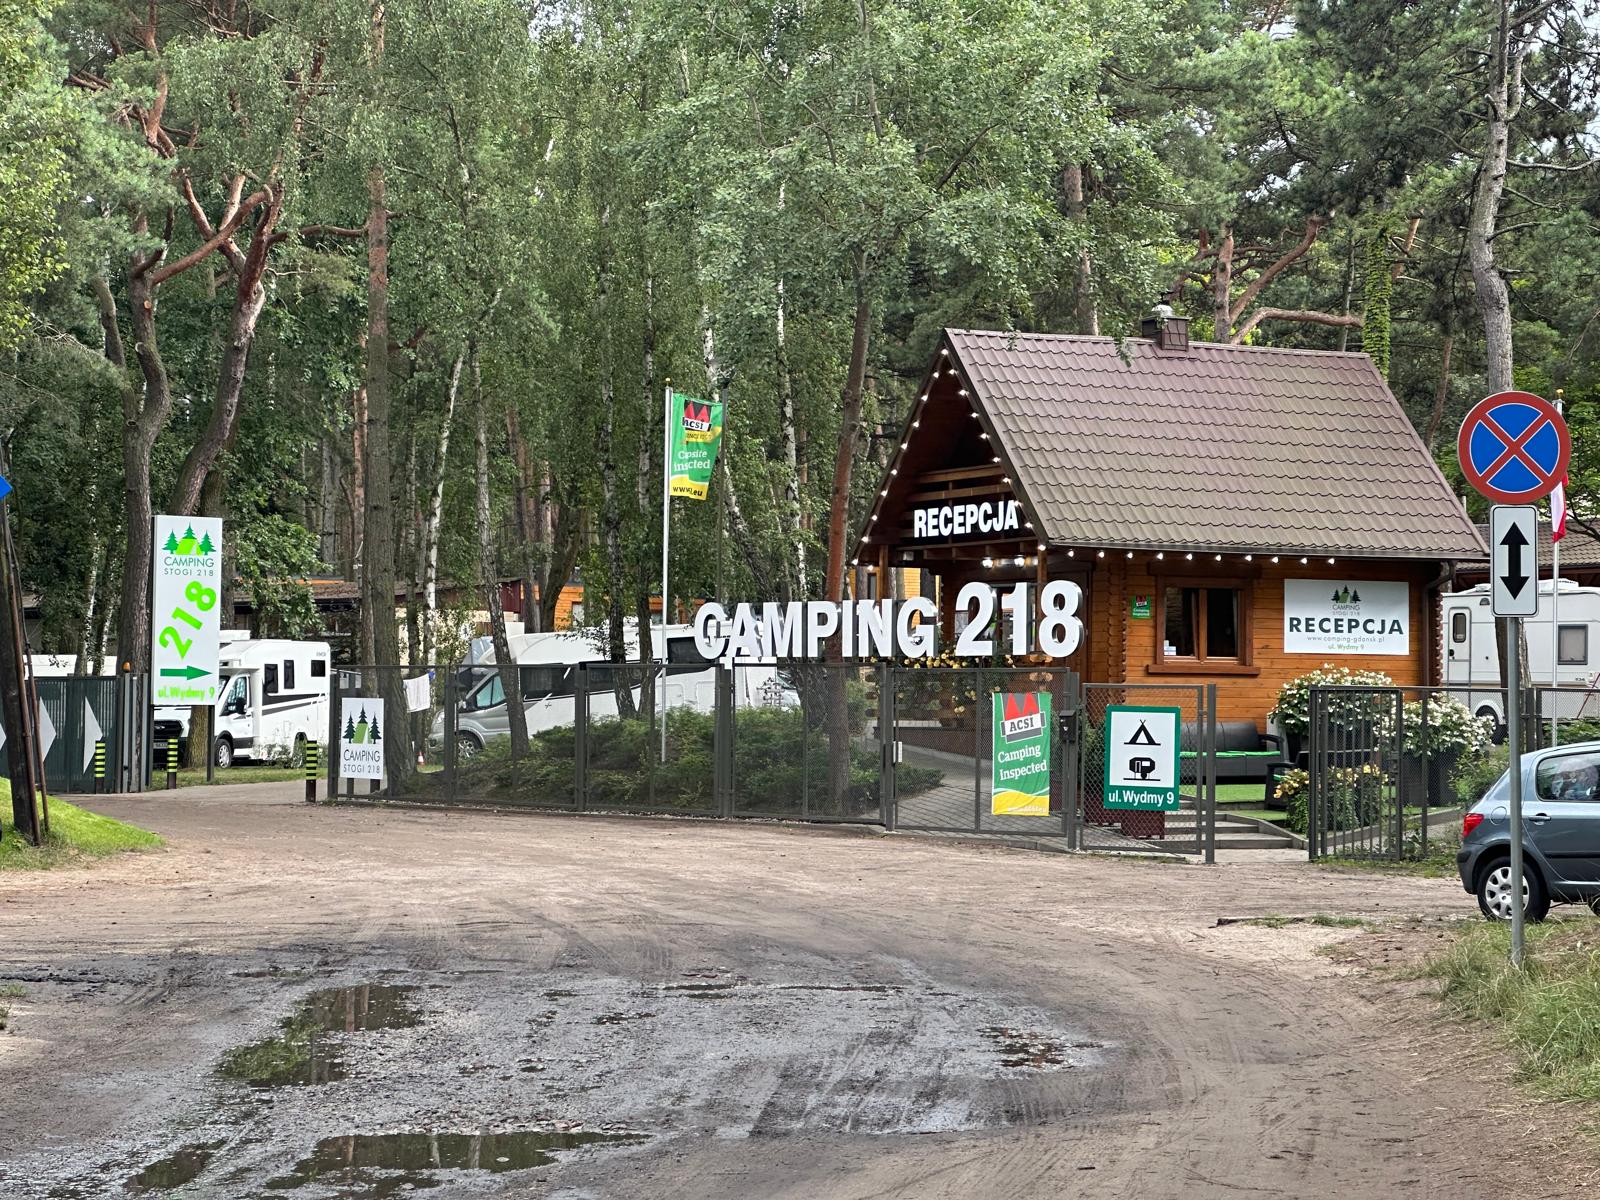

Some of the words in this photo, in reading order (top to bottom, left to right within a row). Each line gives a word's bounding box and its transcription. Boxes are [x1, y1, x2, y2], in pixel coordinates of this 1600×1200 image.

[913, 499, 1019, 538] RECEPCJA
[163, 556, 215, 568] CAMPING
[163, 568, 193, 576] STOGI
[196, 569, 214, 577] 218
[1332, 603, 1361, 611] CAMPING
[158, 580, 217, 660] 218
[694, 596, 939, 660] CAMPING
[954, 579, 1084, 658] 218
[1289, 616, 1404, 635] RECEPCJA
[170, 686, 205, 701] Wydmy
[209, 686, 215, 698] 9
[1009, 714, 1035, 733] ACSI
[343, 749, 381, 763] CAMPING
[998, 744, 1042, 764] Camping
[343, 763, 365, 773] STOGI
[367, 765, 381, 774] 218
[999, 760, 1048, 781] Inspected
[1122, 789, 1164, 807] Wydmy
[1166, 791, 1175, 805] 9
